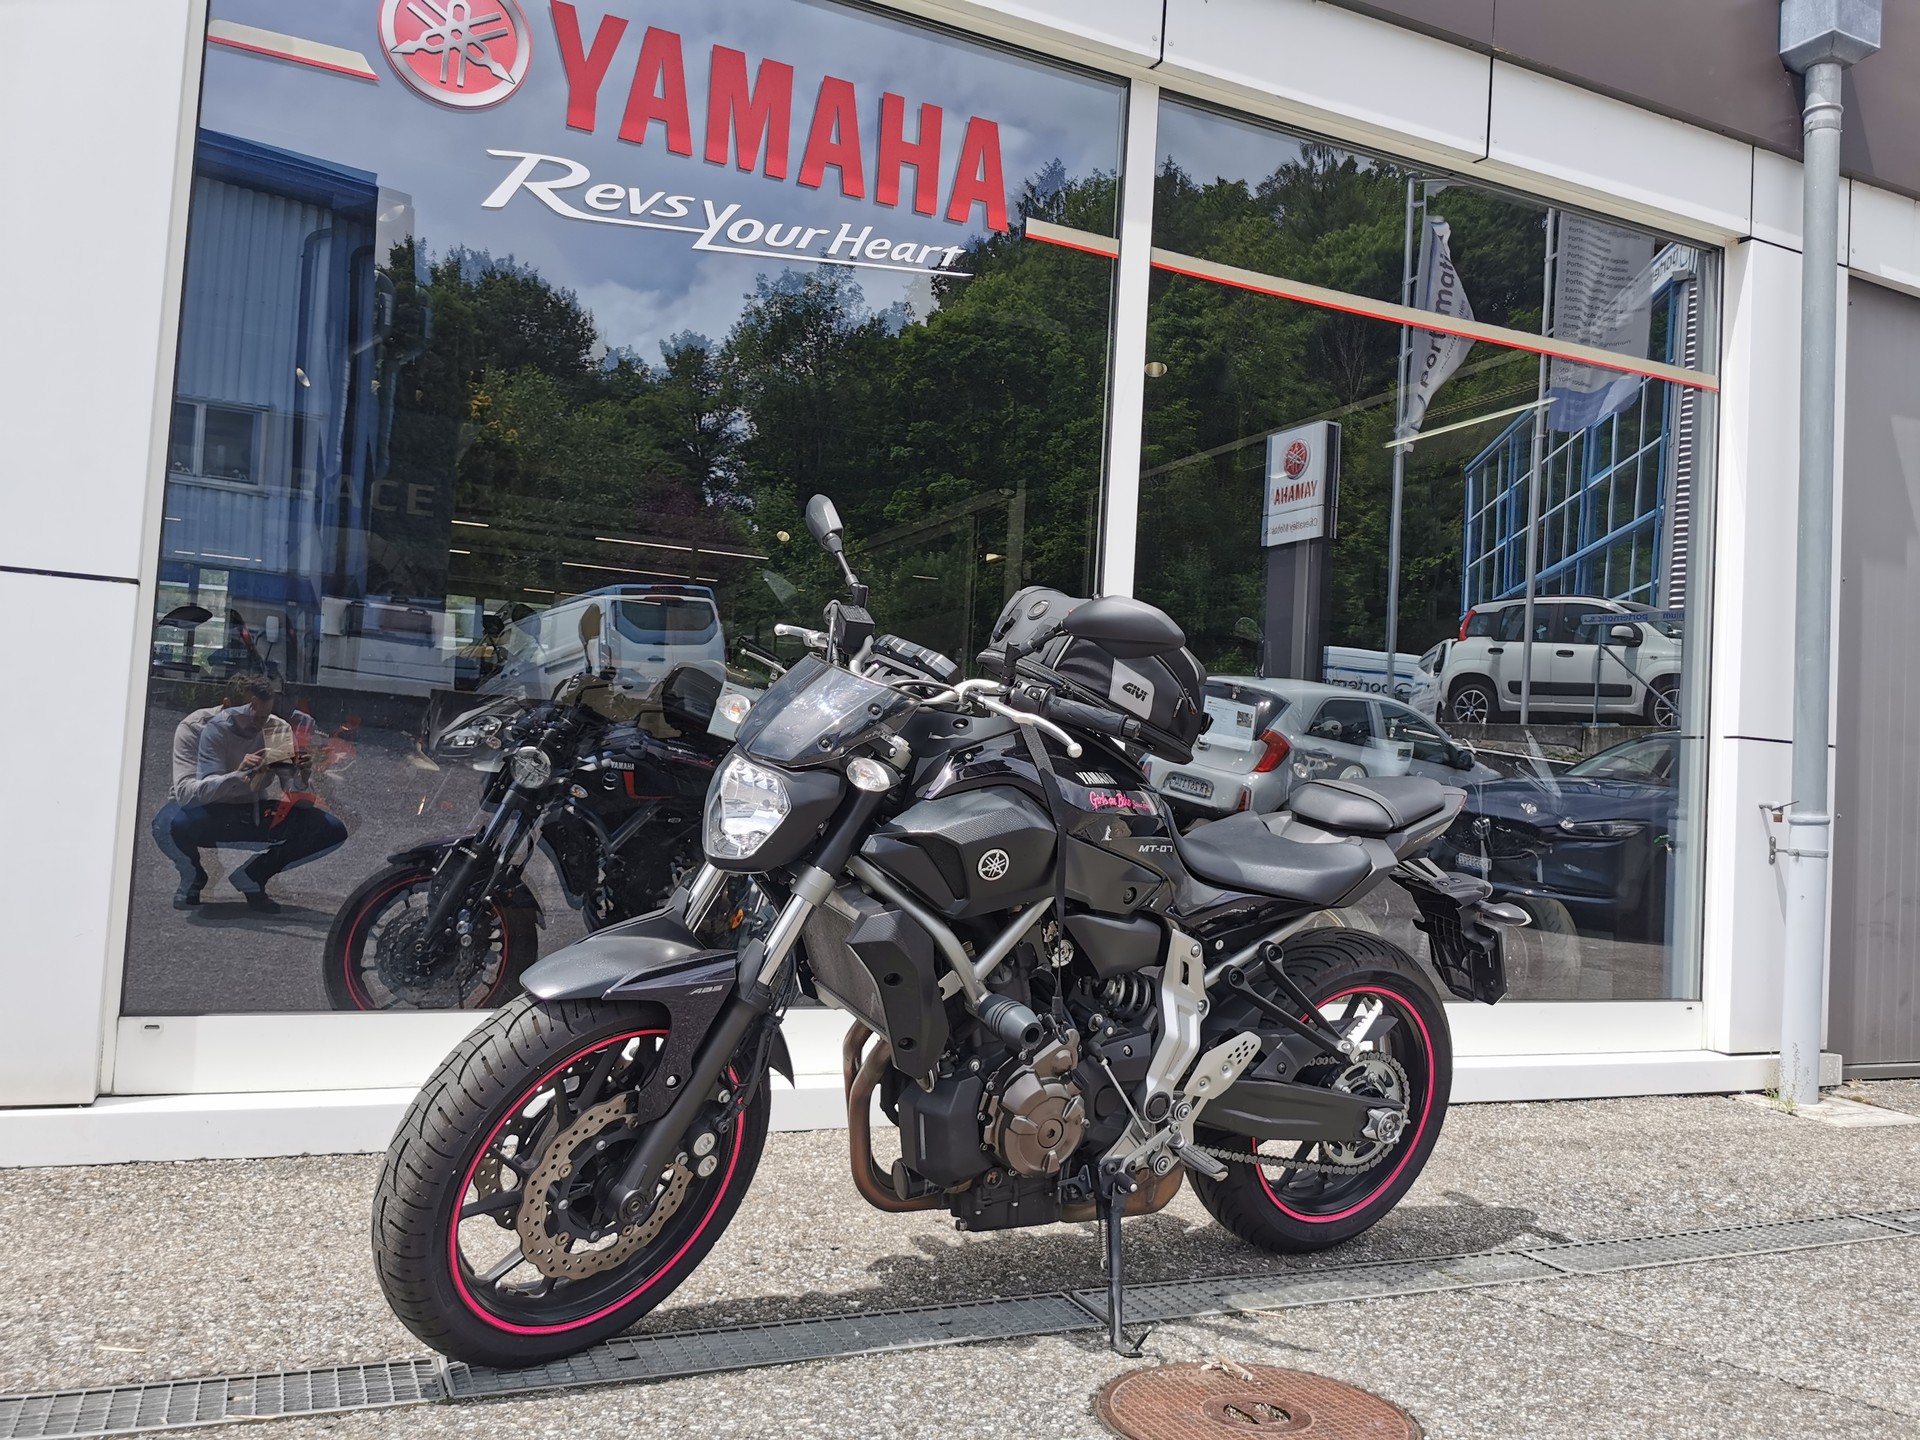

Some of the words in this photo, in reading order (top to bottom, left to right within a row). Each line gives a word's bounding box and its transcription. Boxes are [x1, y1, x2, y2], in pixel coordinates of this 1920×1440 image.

[550, 0, 1008, 232] YAMAHA
[481, 149, 702, 230] Revs
[692, 199, 831, 254] Your
[827, 223, 968, 267] Heart
[1122, 682, 1149, 701] GIVI
[611, 761, 635, 770] YAMAHA
[1075, 771, 1118, 784] YAMAHA
[1138, 844, 1173, 853] MT-07
[688, 984, 724, 995] ABS
